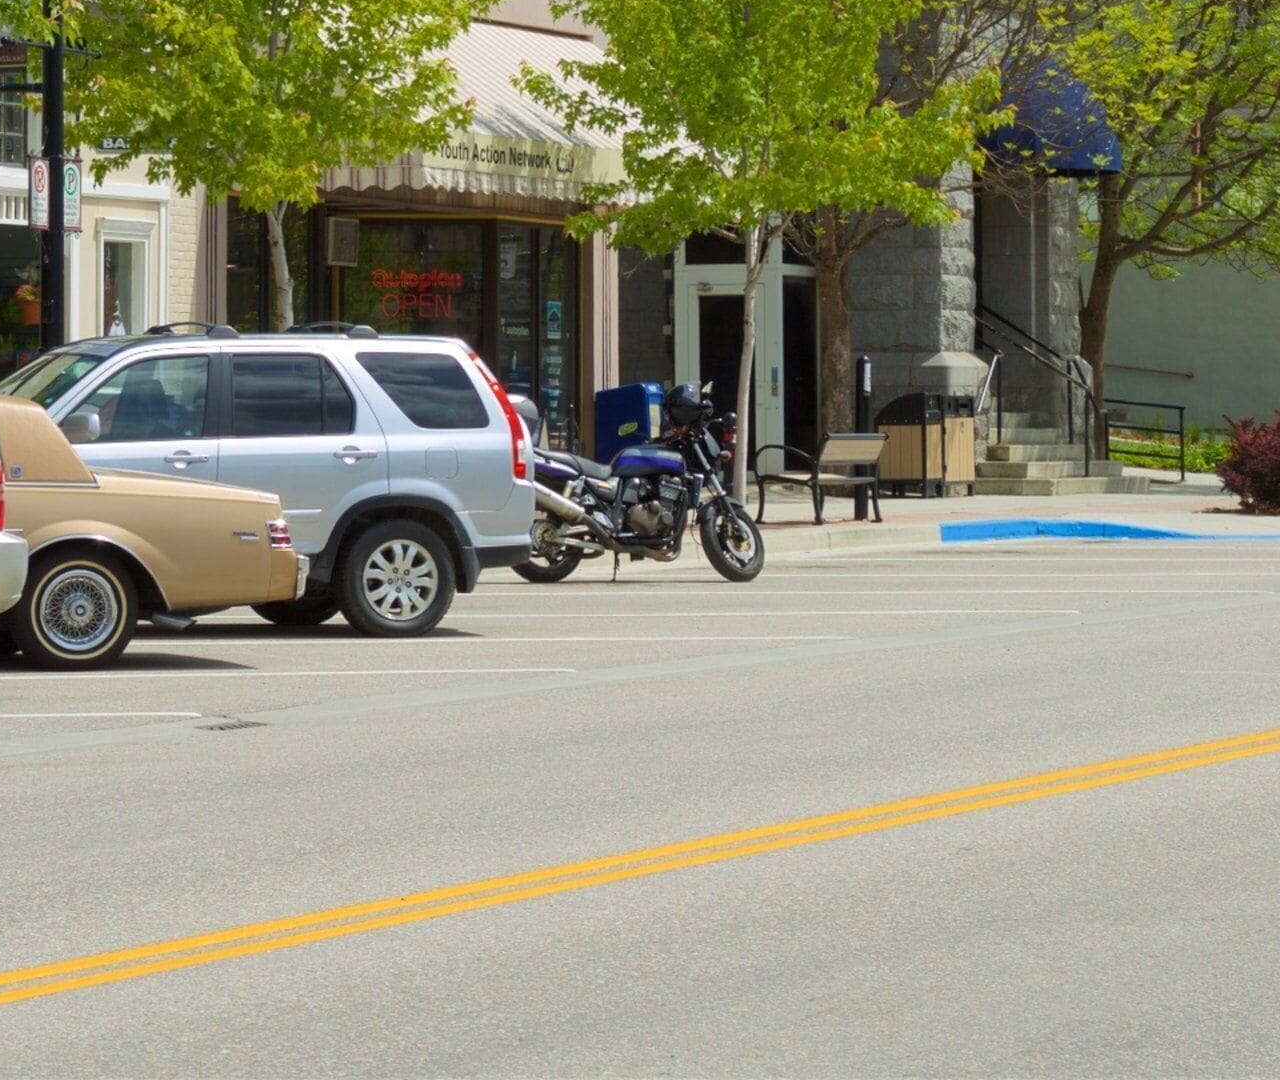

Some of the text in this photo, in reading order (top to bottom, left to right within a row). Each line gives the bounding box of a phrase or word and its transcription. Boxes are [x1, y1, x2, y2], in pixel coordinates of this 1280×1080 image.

[439, 143, 551, 168] Youth Action Network
[382, 293, 452, 318] OPEN
